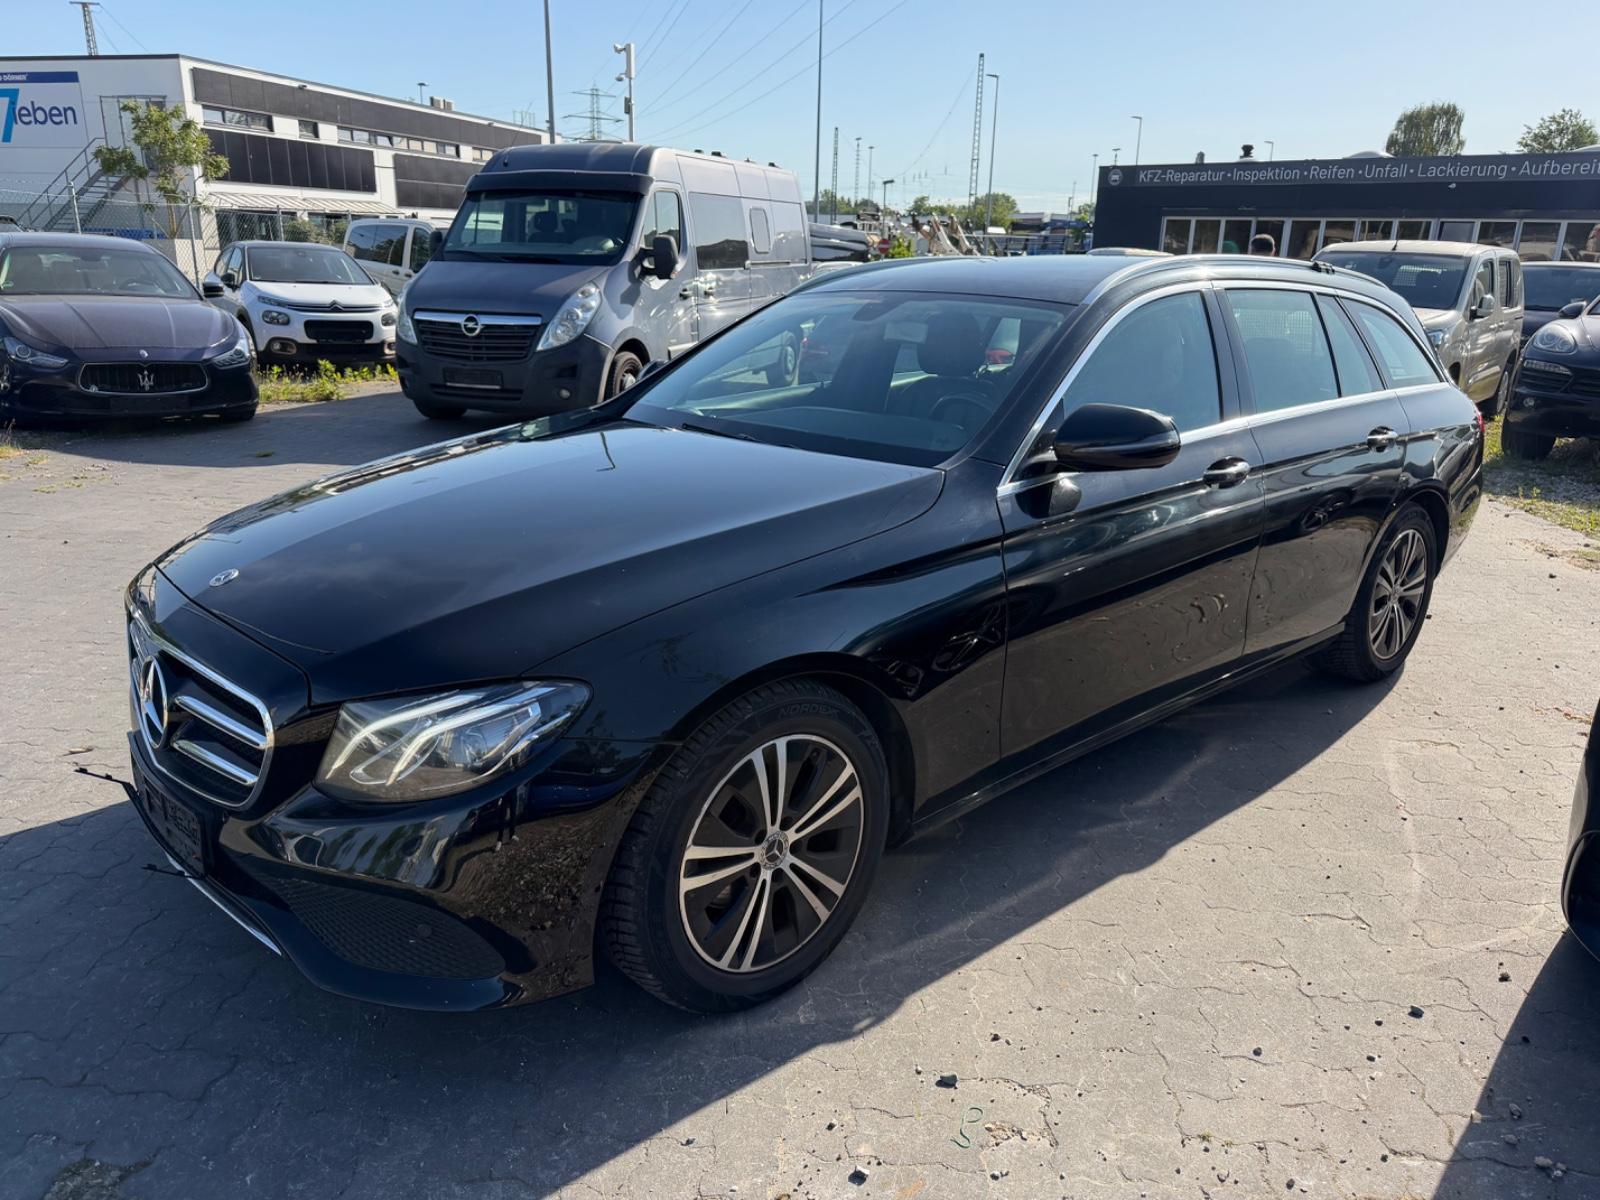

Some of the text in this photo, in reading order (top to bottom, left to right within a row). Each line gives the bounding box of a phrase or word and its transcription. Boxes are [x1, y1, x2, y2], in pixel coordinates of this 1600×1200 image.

[1138, 169, 1225, 184] KFZ-Reparatur
[1233, 167, 1301, 182] Inspektion
[1309, 165, 1355, 180] Reifen
[1364, 164, 1407, 178] Unfall
[1417, 161, 1507, 179] Lackierung
